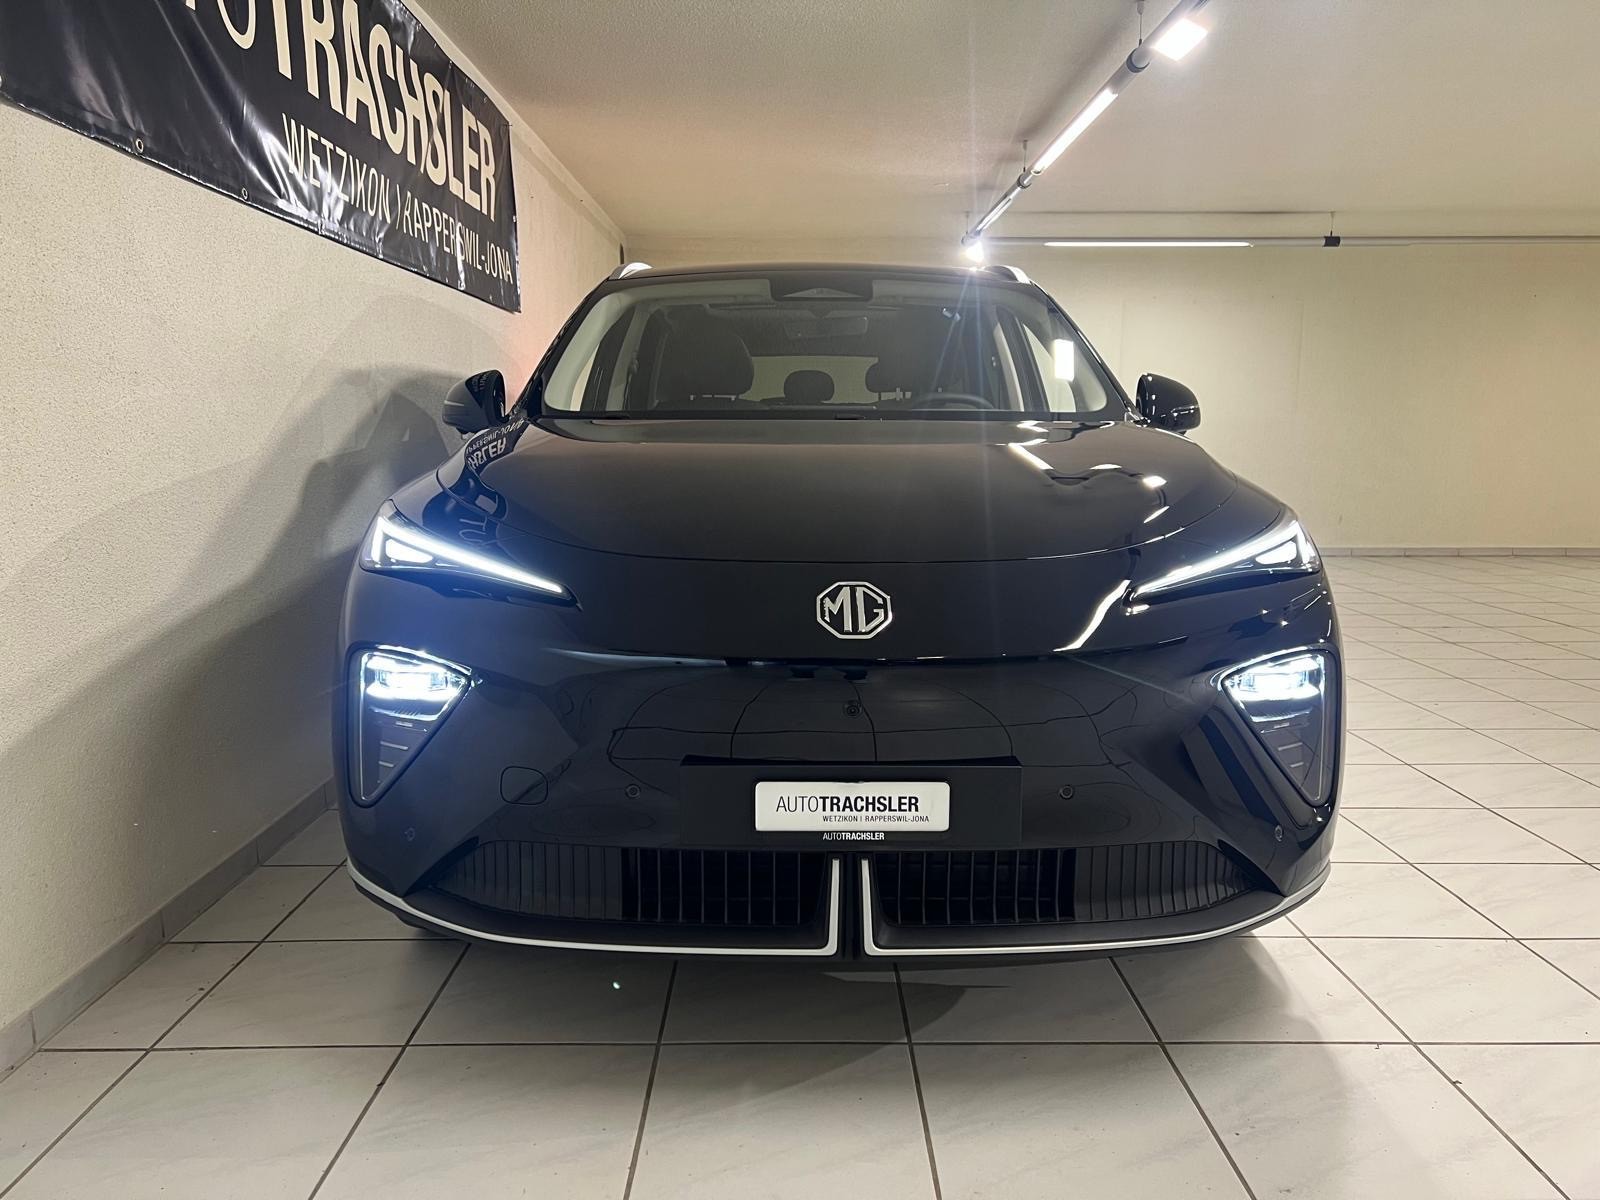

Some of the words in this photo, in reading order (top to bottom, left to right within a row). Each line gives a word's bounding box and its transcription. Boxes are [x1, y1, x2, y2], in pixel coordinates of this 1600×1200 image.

[282, 113, 391, 224] WETZIKON
[403, 191, 513, 285] RAPPERSWIL-JONA
[823, 586, 884, 633] MG
[776, 796, 919, 813] AUTOTRACHSLER
[823, 832, 885, 841] AUTOTRACHSLER
